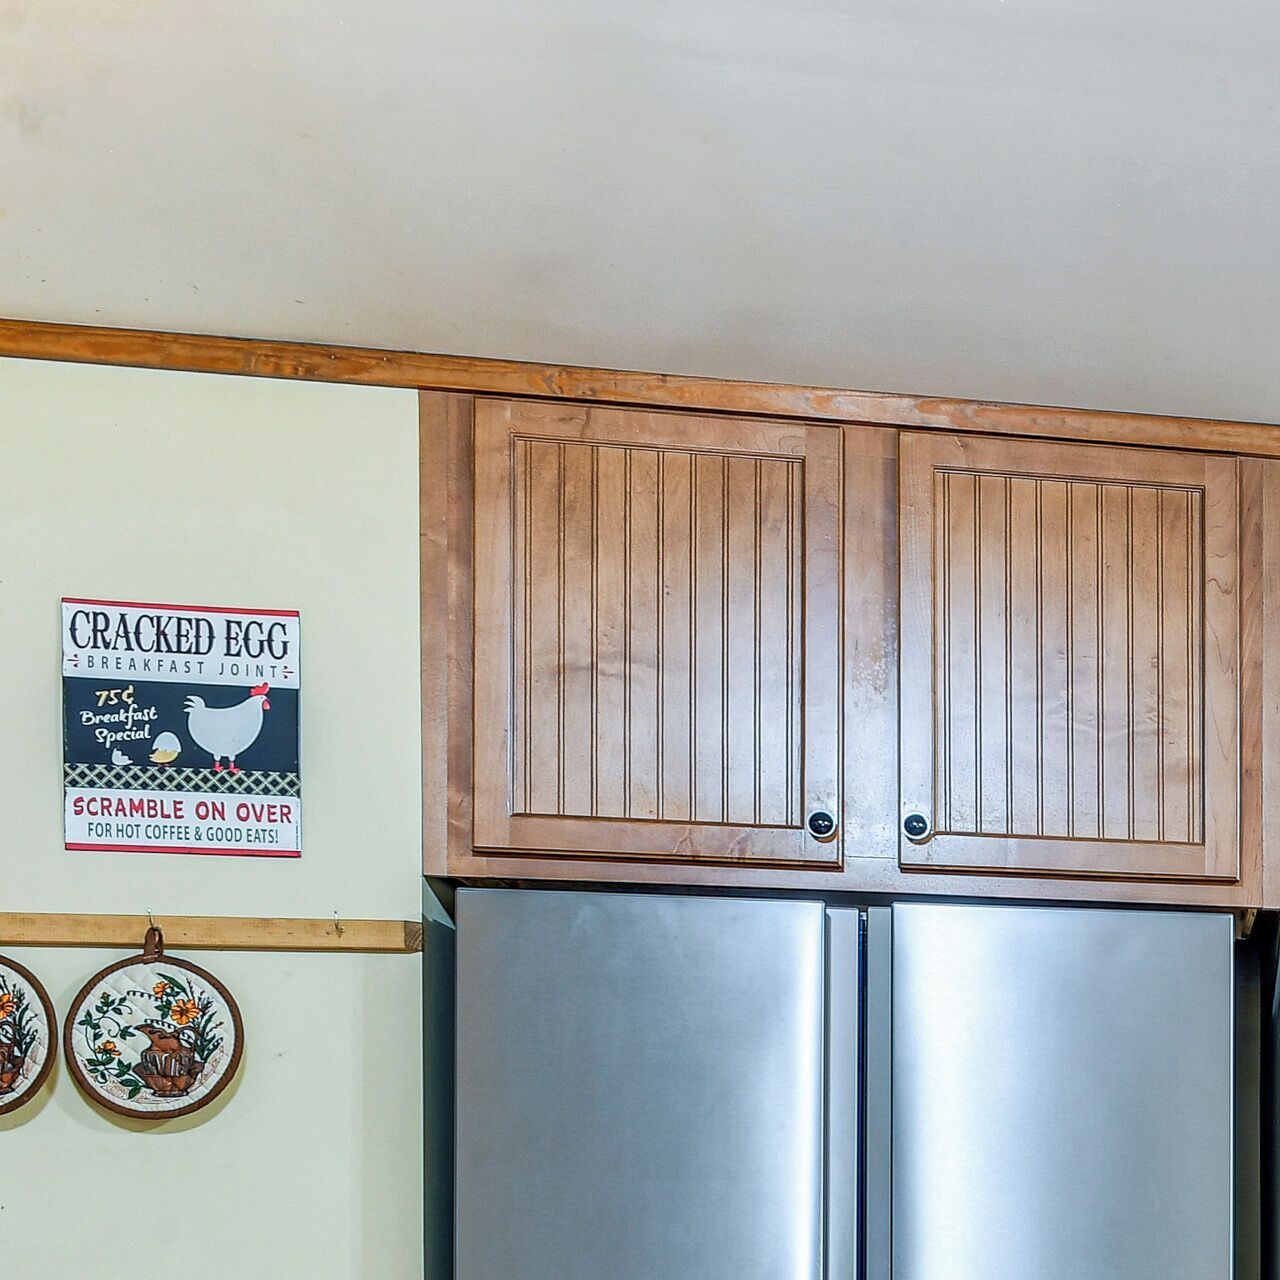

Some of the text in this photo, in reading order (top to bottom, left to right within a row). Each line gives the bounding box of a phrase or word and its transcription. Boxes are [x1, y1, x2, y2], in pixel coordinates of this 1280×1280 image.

[69, 610, 290, 660] CRACKED EGG
[87, 655, 278, 679] BREAKFAST JOINT
[95, 685, 134, 706] 75¢
[80, 703, 158, 729] Breakfast
[95, 725, 151, 748] Special
[73, 797, 292, 824] SCRAMBLE ON OVER
[87, 823, 113, 839] FOR
[116, 823, 141, 839] HOT
[145, 824, 190, 841] COFFEE
[194, 826, 203, 841] &
[206, 827, 243, 842] GOOD
[246, 828, 279, 844] EATS!
